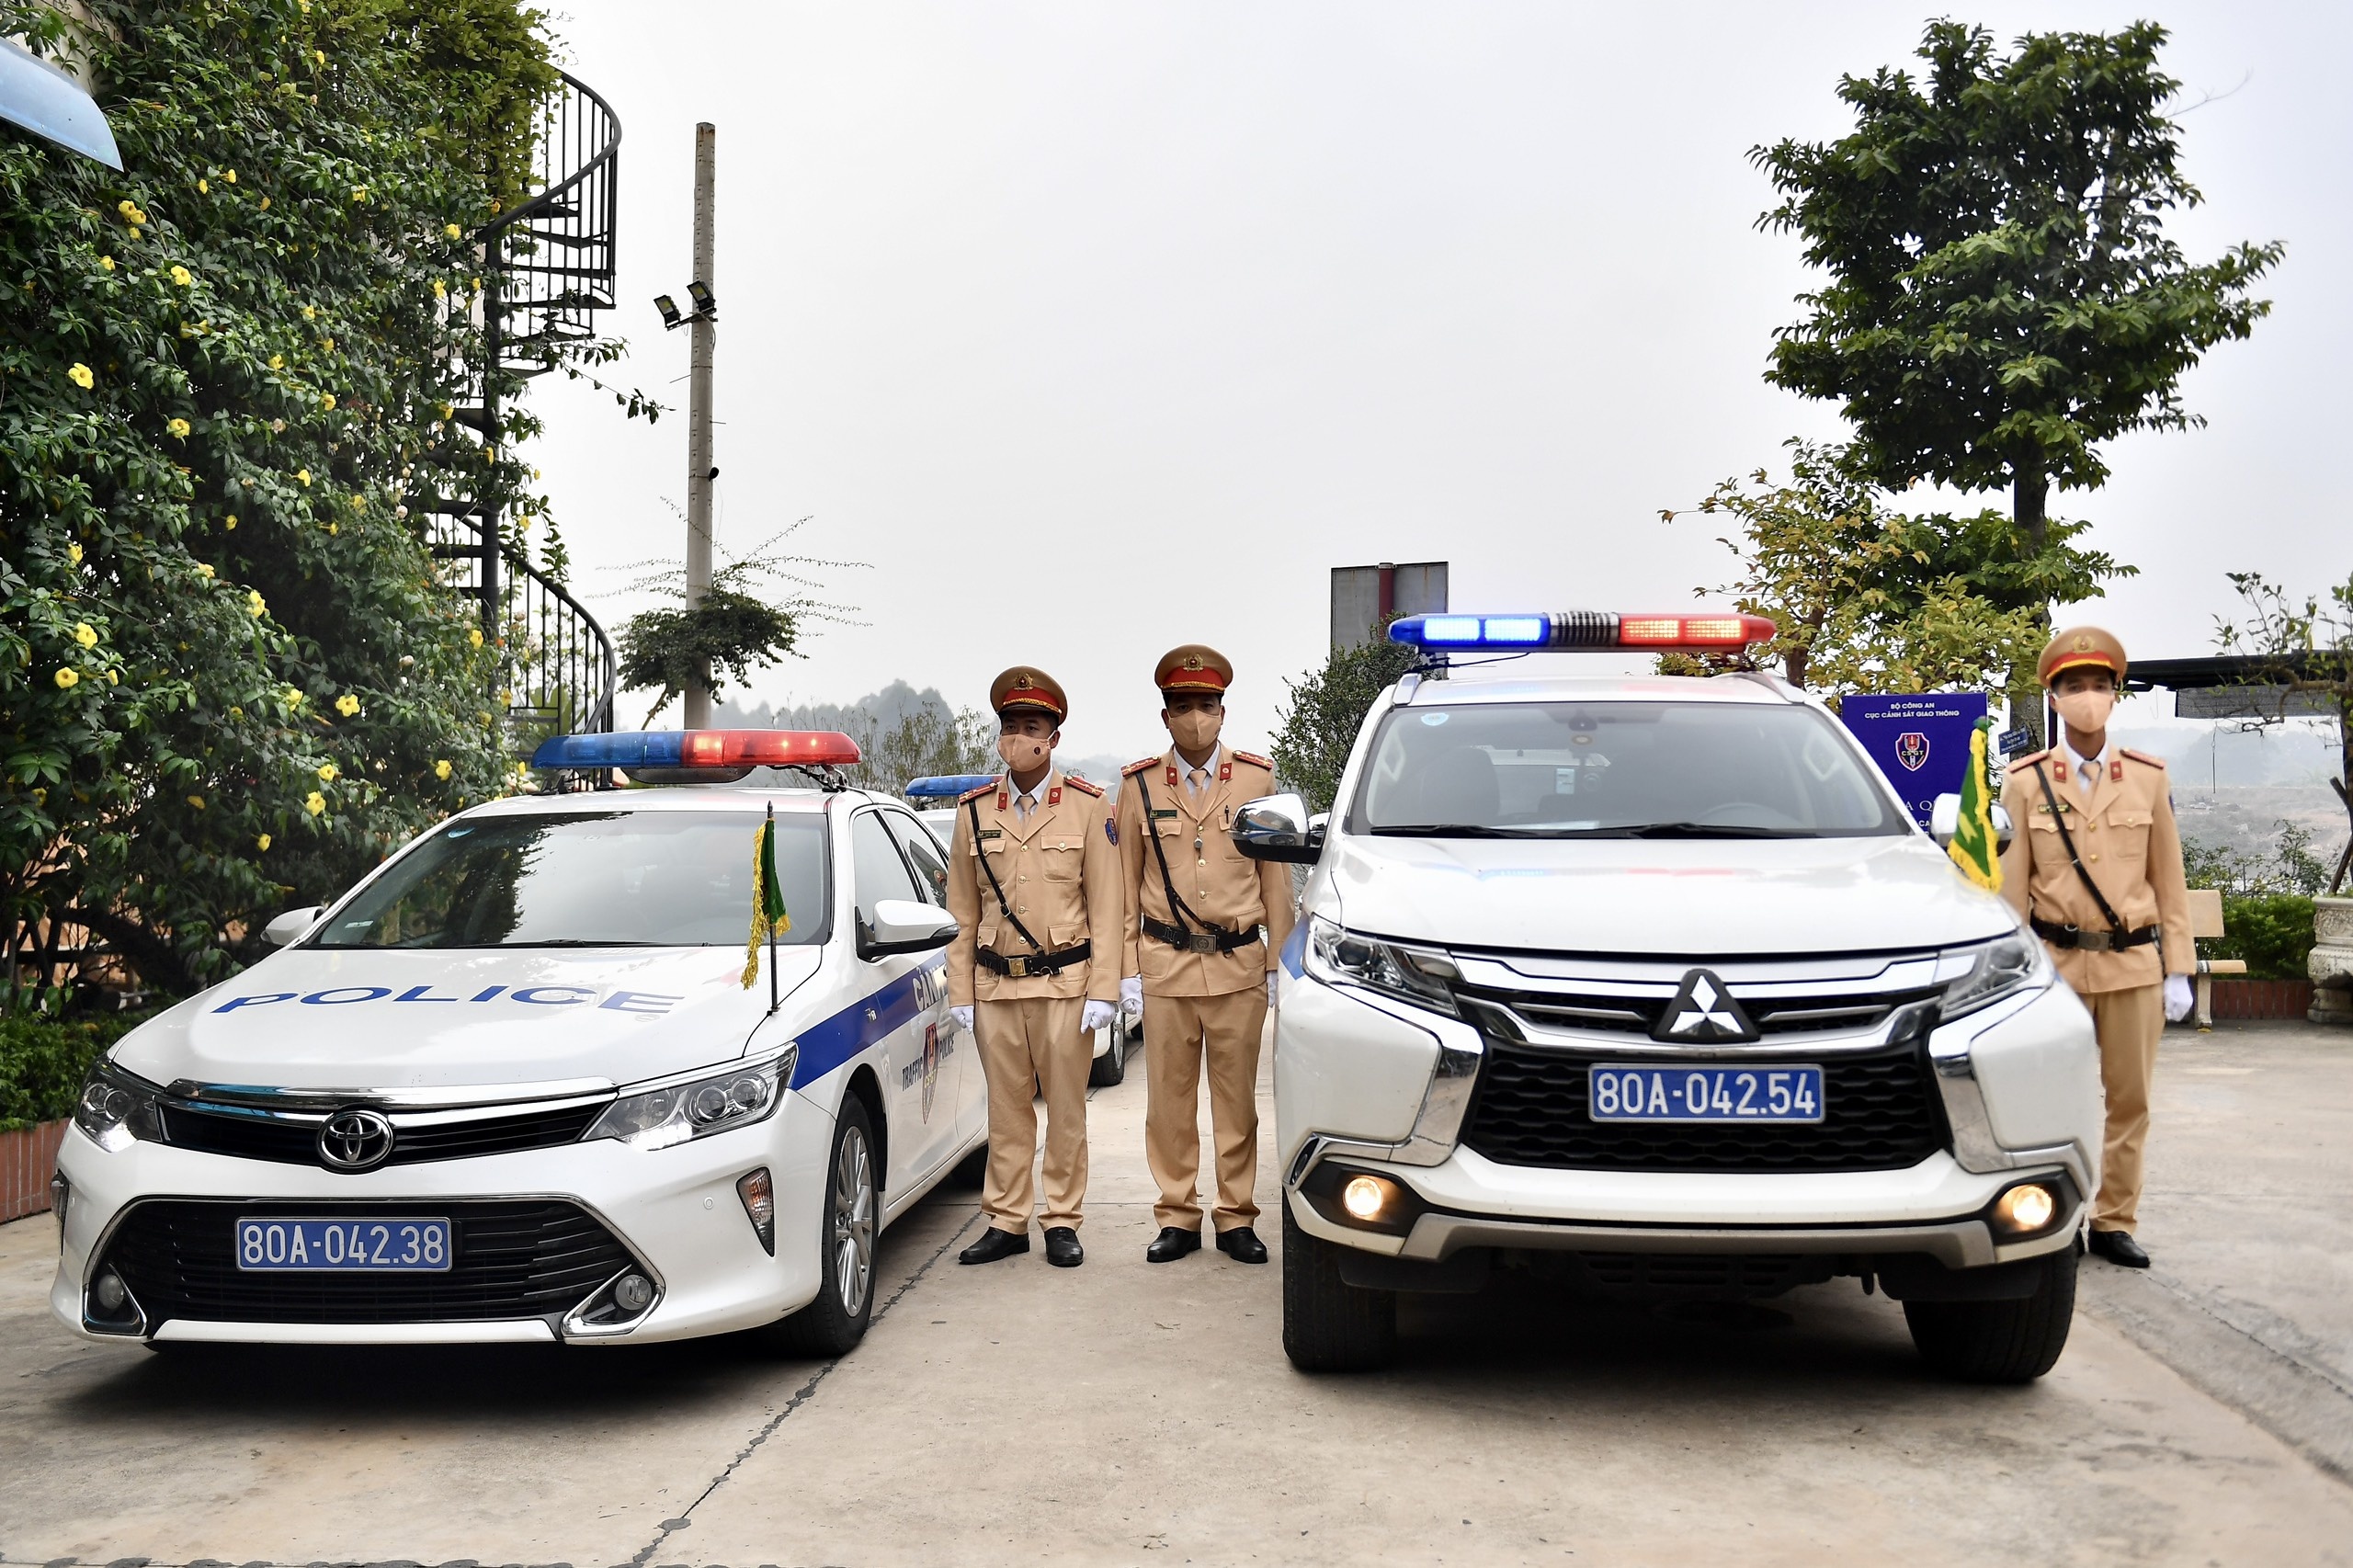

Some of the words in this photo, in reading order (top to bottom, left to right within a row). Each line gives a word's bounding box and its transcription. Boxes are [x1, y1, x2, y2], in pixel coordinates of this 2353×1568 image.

[1890, 702, 1901, 710] BỘ
[1902, 701, 1923, 710] CÔNG
[210, 985, 685, 1014] POLICE
[902, 1056, 924, 1092] TRAFFIC
[938, 1031, 955, 1062] POLICE
[1597, 1072, 1816, 1115] 80A-042.54
[243, 1224, 444, 1264] 80A-042.38
